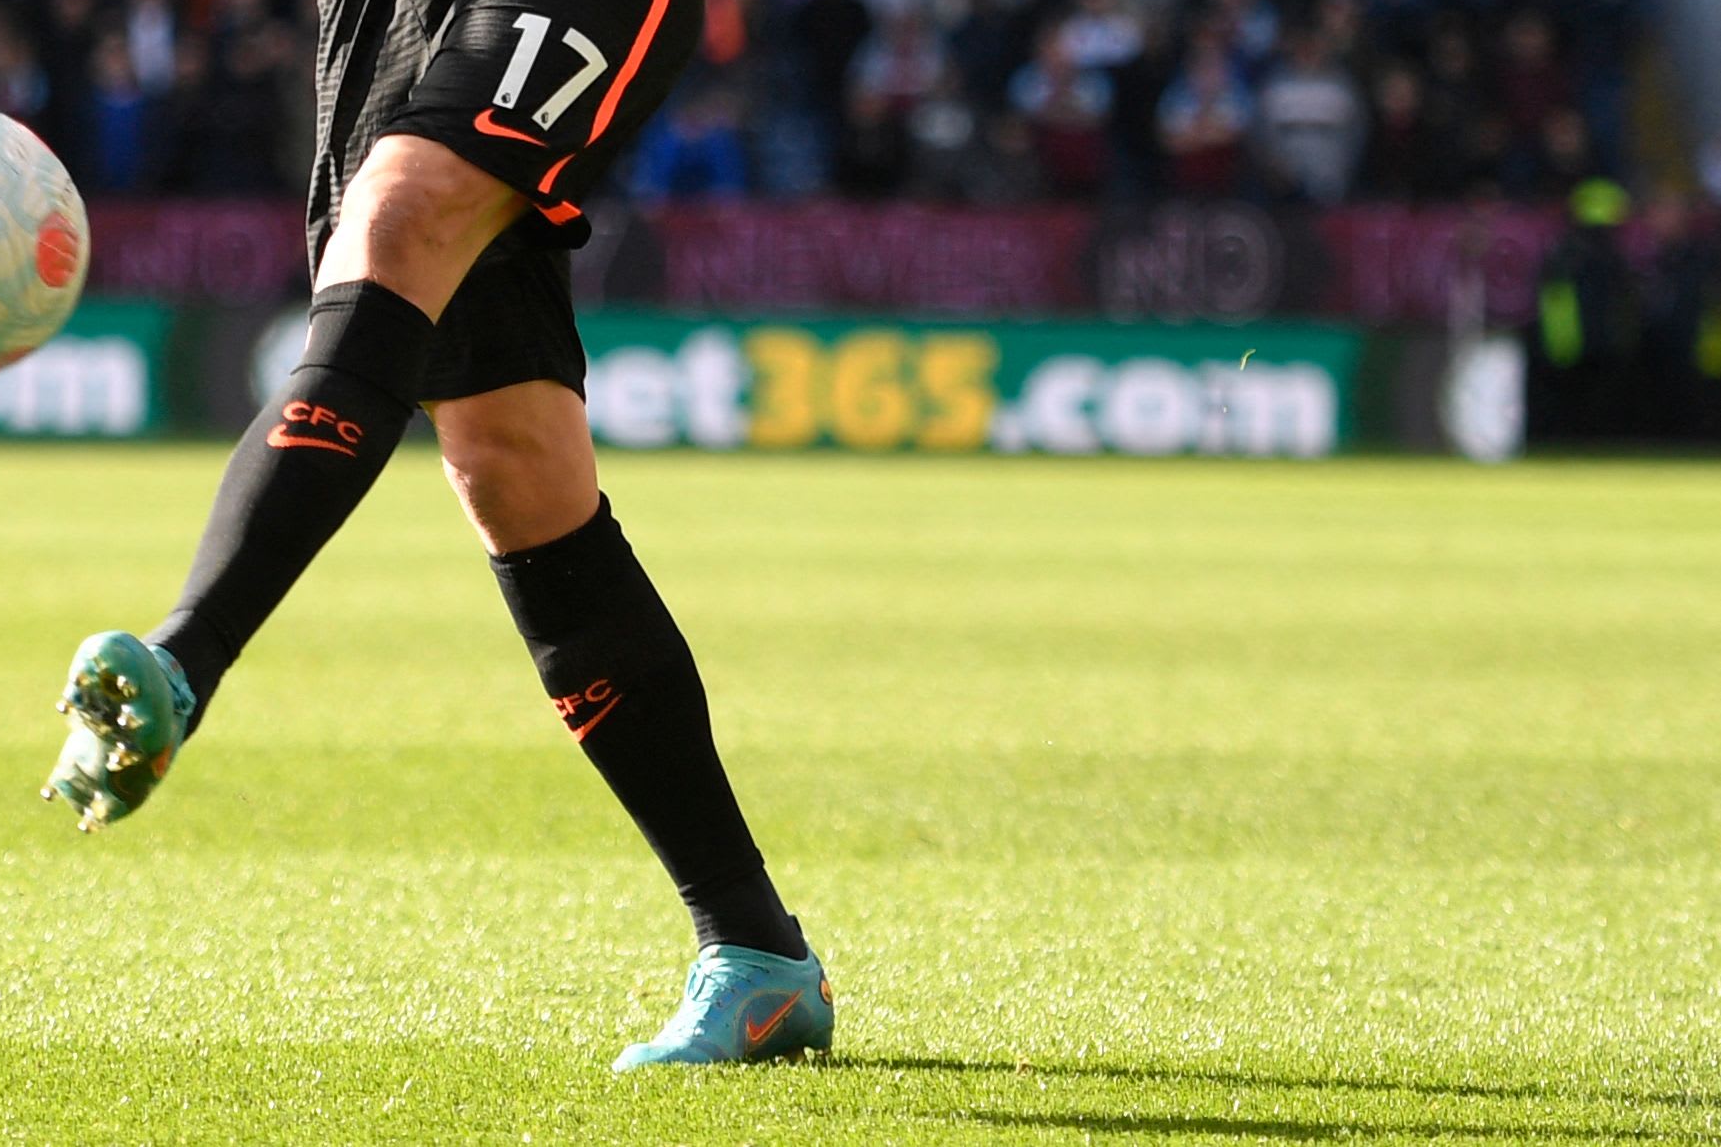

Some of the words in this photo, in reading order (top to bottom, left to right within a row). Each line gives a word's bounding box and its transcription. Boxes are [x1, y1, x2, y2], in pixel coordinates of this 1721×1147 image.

[492, 12, 609, 132] 17
[282, 401, 364, 444] CFC
[586, 326, 1343, 453] et365.com
